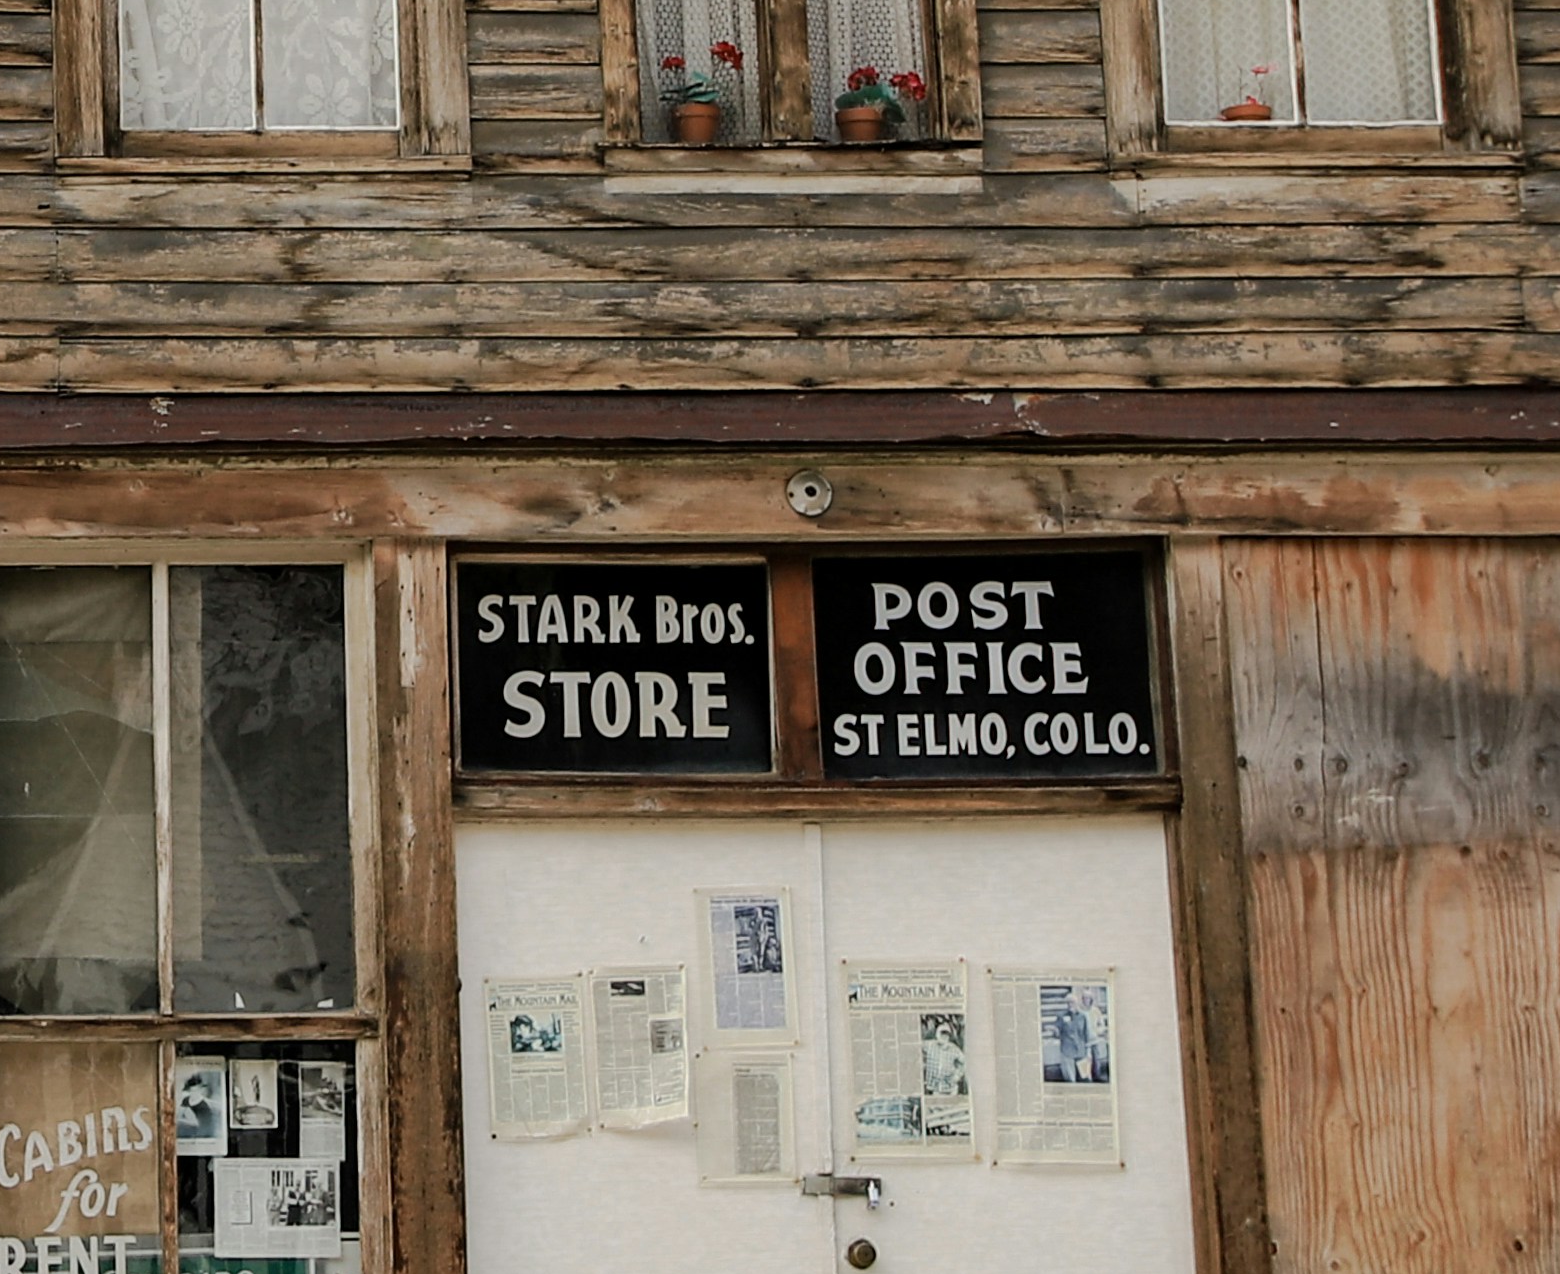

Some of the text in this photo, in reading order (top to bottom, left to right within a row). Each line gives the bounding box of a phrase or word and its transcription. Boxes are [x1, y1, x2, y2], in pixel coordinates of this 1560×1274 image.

[477, 593, 756, 645] STARK Bros.
[870, 580, 1055, 630] POST
[853, 641, 1090, 695] OFFICE
[501, 669, 731, 739] STORE
[833, 711, 1151, 760] ST ELMO, COLO.
[43, 1168, 129, 1233] for
